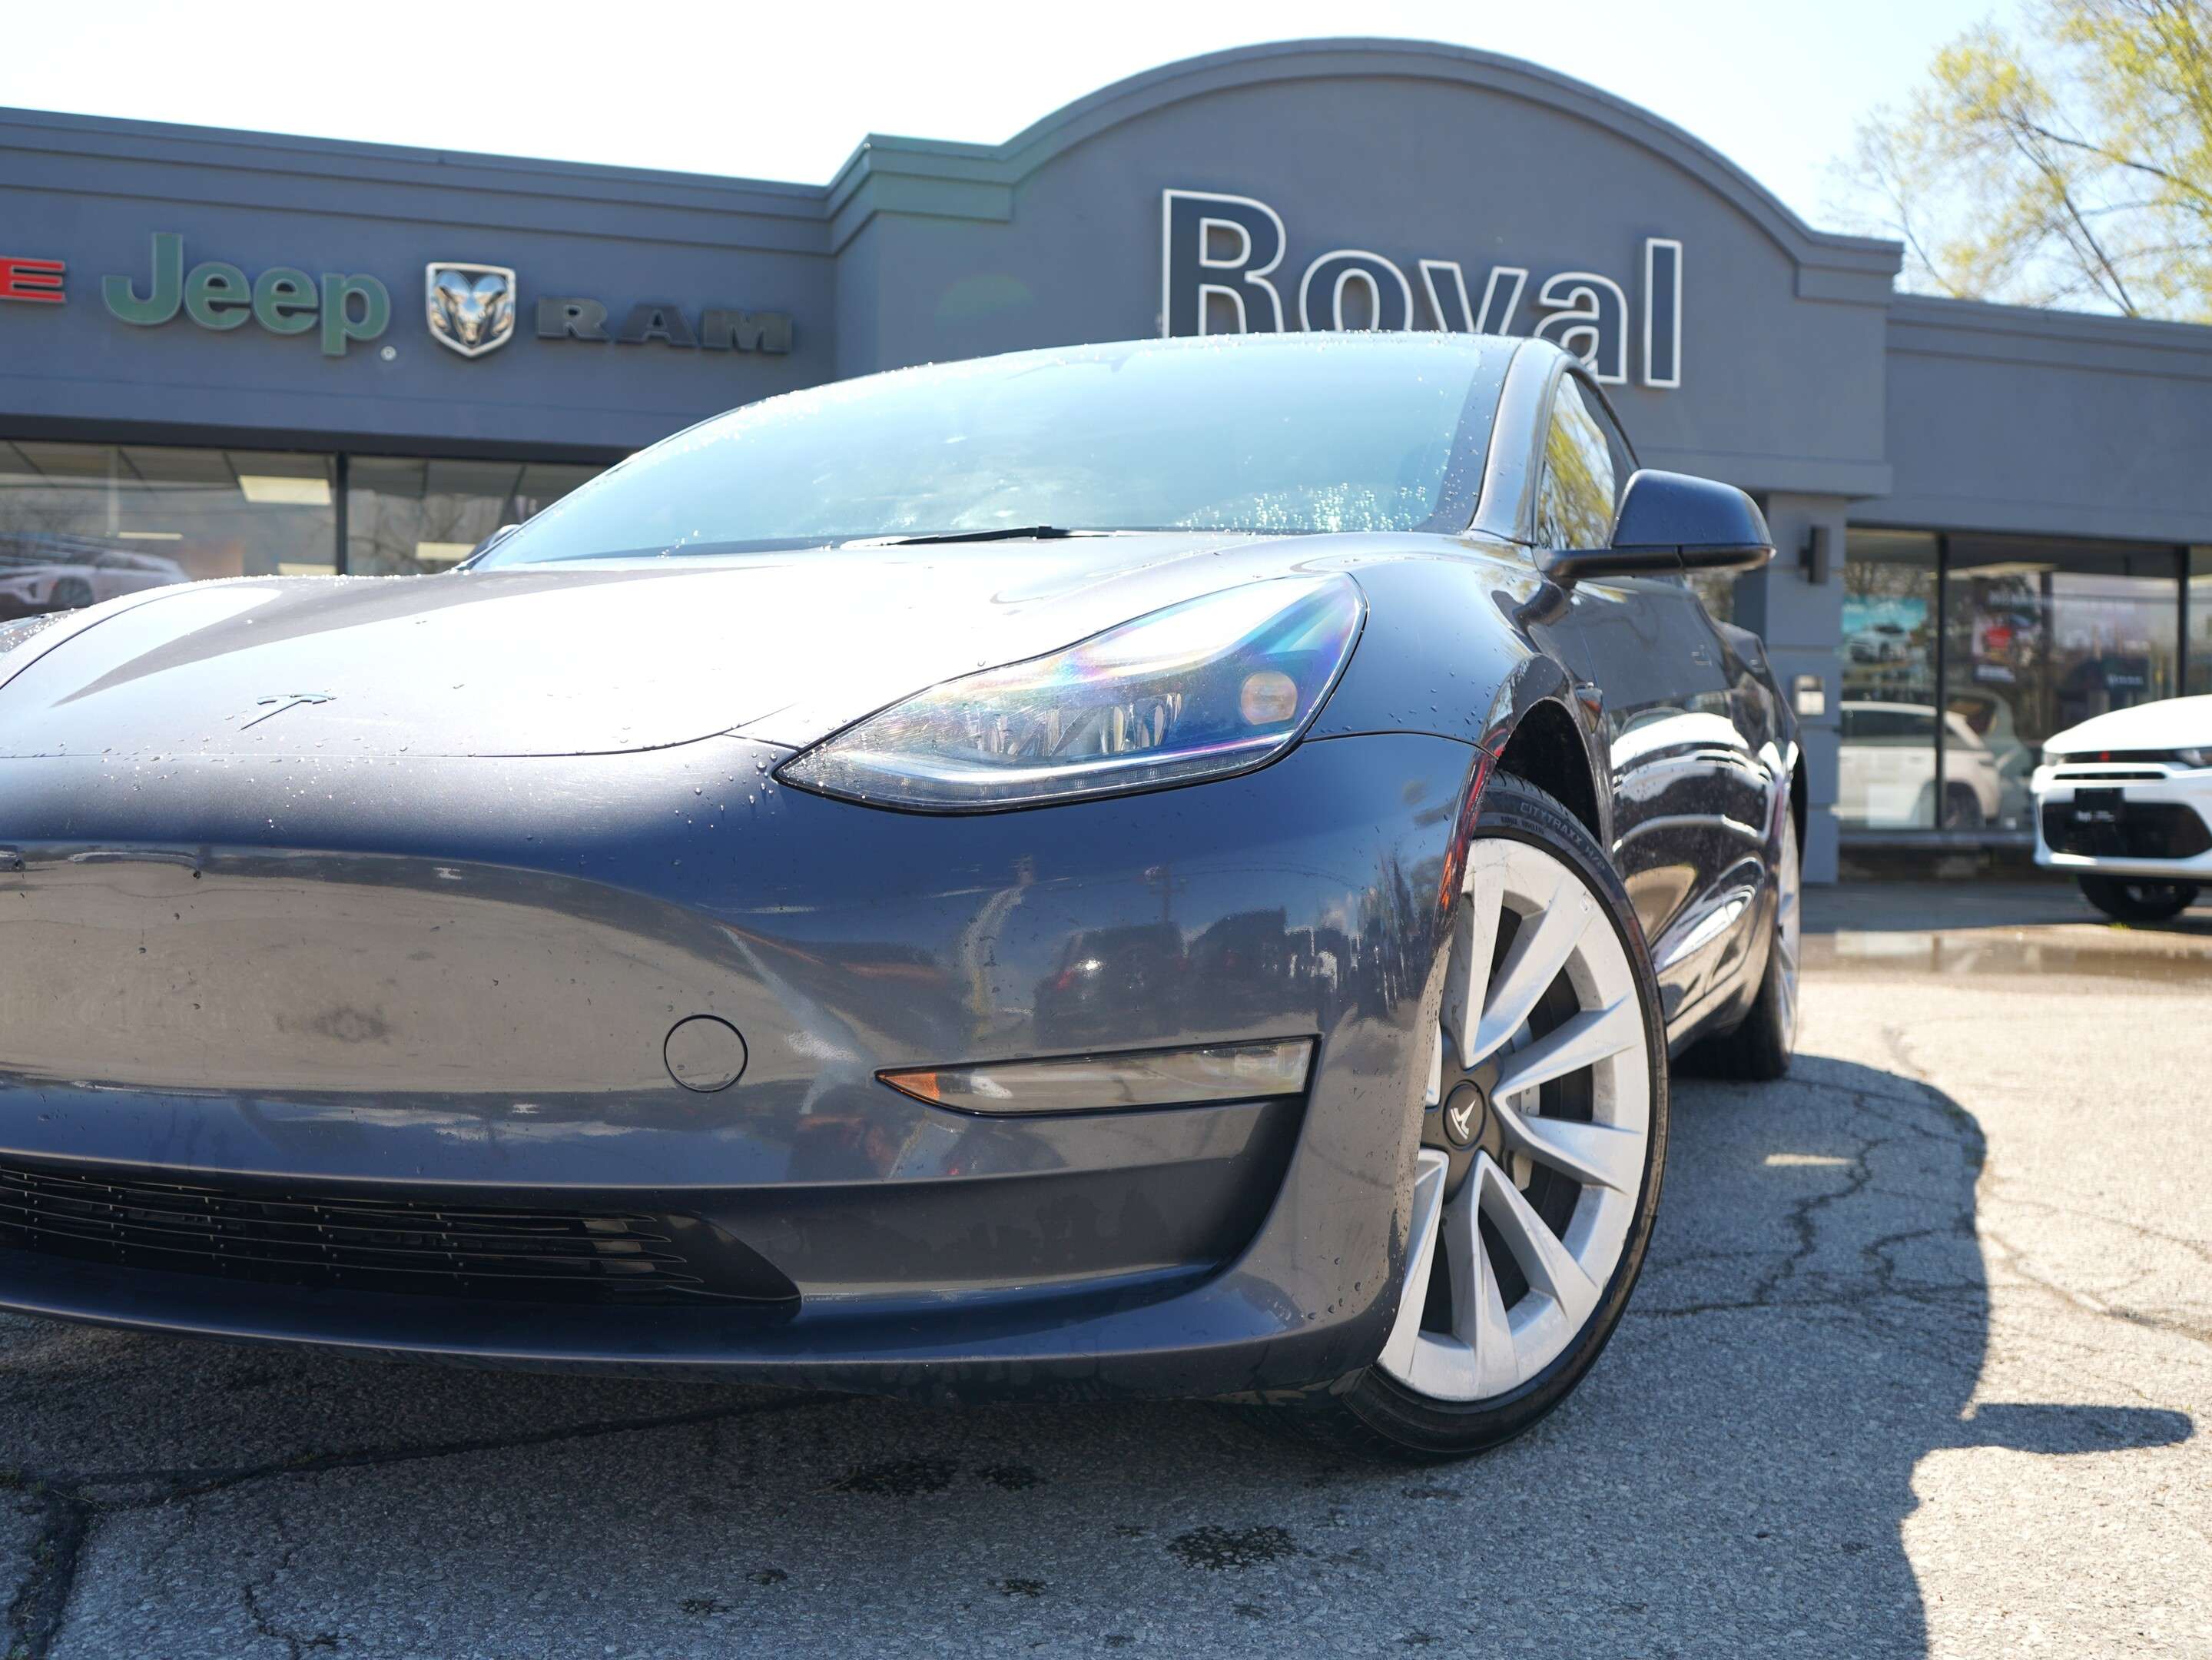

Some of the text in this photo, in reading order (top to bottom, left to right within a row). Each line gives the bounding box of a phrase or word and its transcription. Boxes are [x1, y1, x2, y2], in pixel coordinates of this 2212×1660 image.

[102, 233, 391, 357] Jeep
[536, 296, 794, 354] RAM
[1520, 802, 1582, 845] CITYTRAXX
